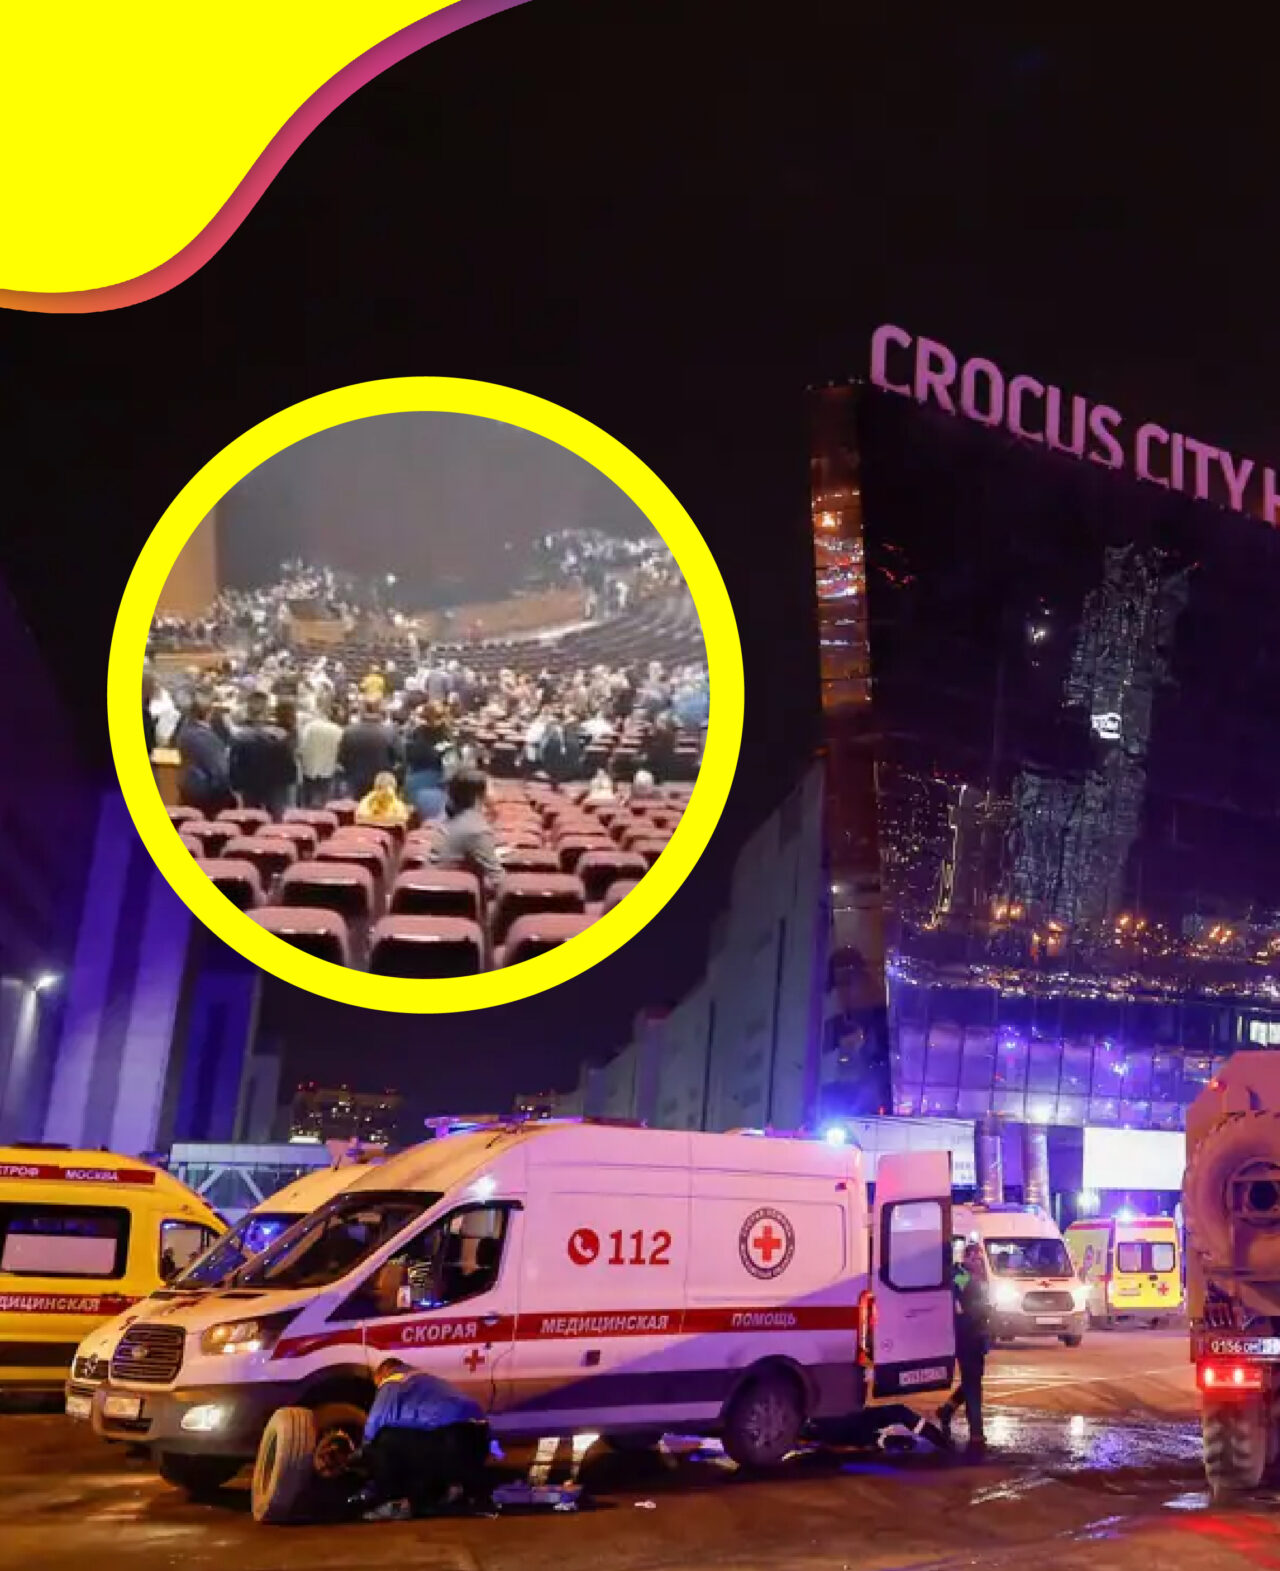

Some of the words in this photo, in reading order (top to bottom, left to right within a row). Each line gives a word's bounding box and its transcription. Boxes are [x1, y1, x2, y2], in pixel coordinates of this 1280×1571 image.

[870, 324, 1124, 470] CROCUS
[1135, 422, 1253, 512] CITY
[607, 1229, 673, 1267] 112
[401, 1320, 478, 1343] СКОРАЯ
[540, 1315, 670, 1335] МЕДИЦИНСКАЯ
[731, 1312, 796, 1329] ПОМОЩЬ
